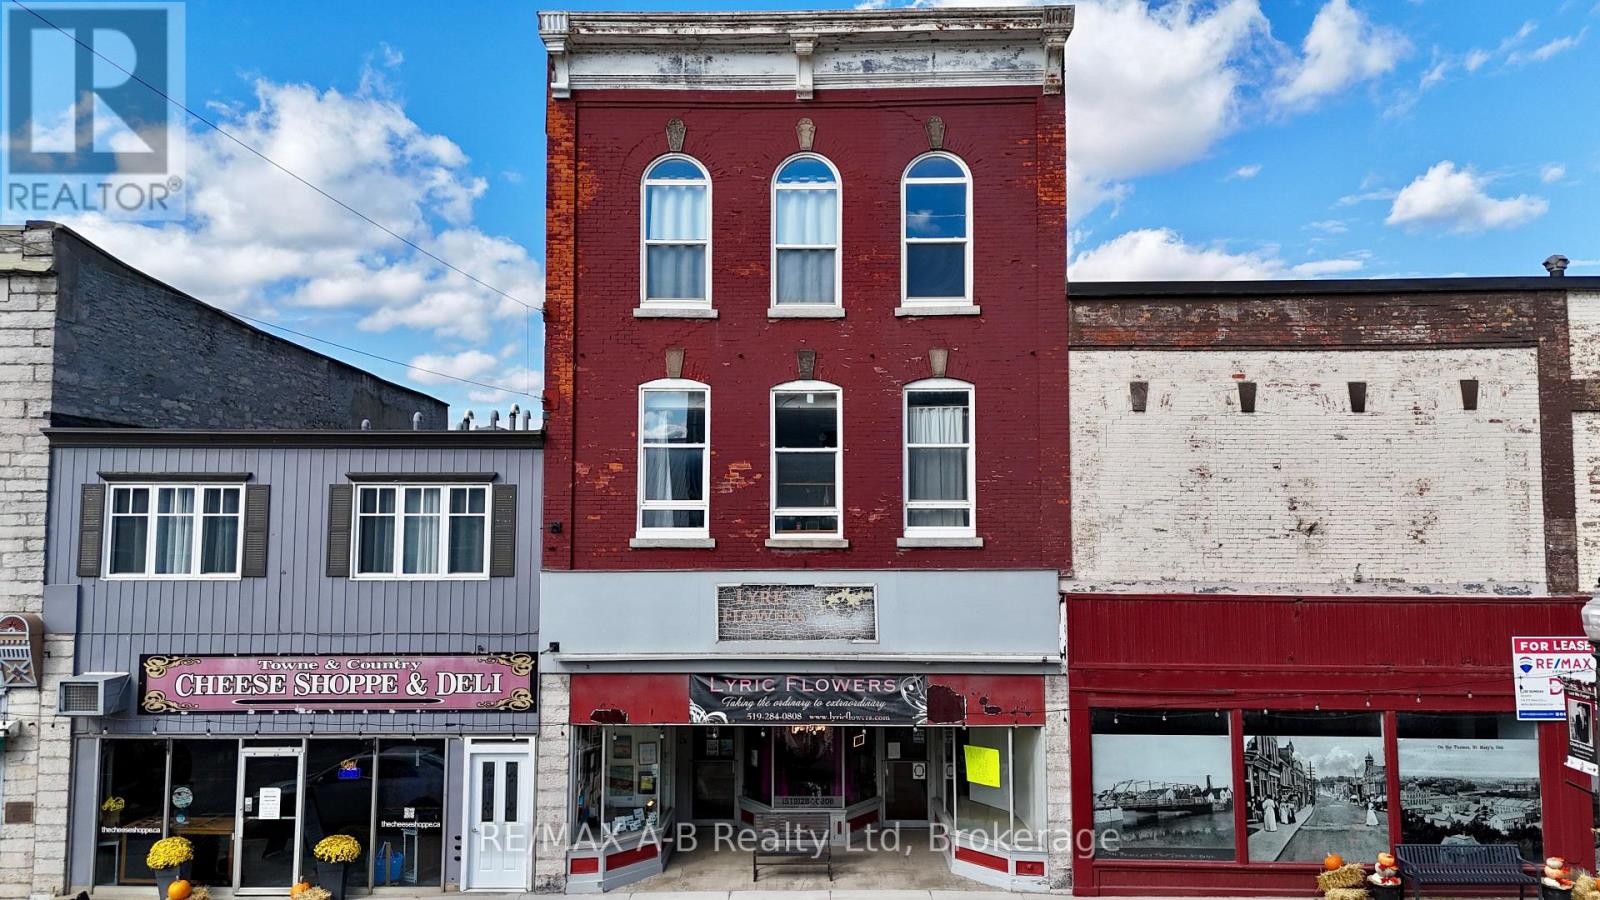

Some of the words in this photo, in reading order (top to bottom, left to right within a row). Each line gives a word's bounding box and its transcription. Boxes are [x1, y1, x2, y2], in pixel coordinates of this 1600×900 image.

[1520, 642, 1549, 651] FOR
[1553, 640, 1592, 651] LEASE
[258, 659, 319, 670] Towne
[325, 659, 341, 670] &
[346, 659, 422, 671] Country
[1536, 657, 1591, 669] RE/MAX
[175, 673, 287, 697] CHEESE
[294, 672, 399, 696] SHOPPE
[405, 672, 429, 696] &
[436, 672, 503, 696] DELI
[710, 676, 776, 692] LYRIC
[786, 676, 896, 692] FLOWERS
[721, 696, 754, 711] Taking
[756, 696, 772, 707] the
[773, 696, 811, 711] ordinary
[813, 698, 822, 707] to
[826, 697, 886, 711] extraordinary
[746, 712, 803, 720] 519-284-0808
[809, 711, 891, 721] www.lyricflowers.com
[101, 826, 161, 834] thecheeseshoppe.ca
[381, 820, 440, 829] thecheeseshoppe.ca
